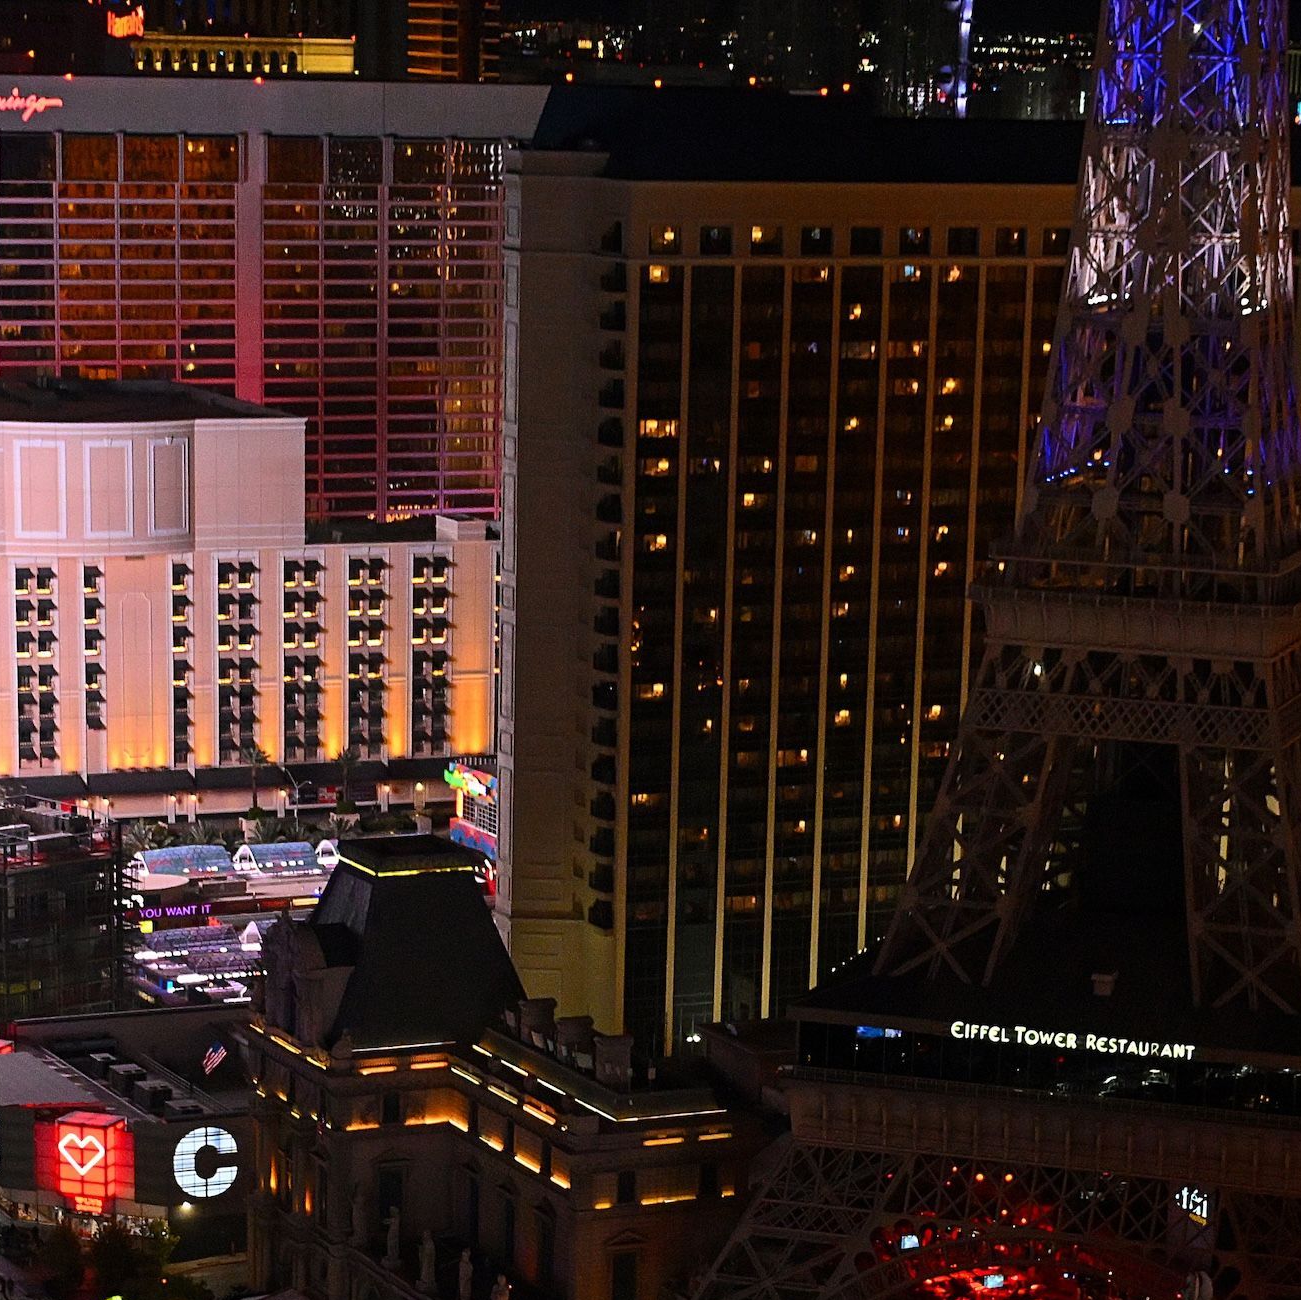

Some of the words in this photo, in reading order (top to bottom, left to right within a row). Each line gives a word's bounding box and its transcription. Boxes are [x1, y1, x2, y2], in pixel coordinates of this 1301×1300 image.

[139, 909, 162, 918] YOU
[165, 905, 197, 917] WANT
[201, 904, 212, 914] IT
[950, 1021, 1010, 1043] EIFFEL
[1014, 1026, 1077, 1049] TOWER
[1085, 1034, 1196, 1060] RESTAURANT
[173, 1126, 239, 1198] C
